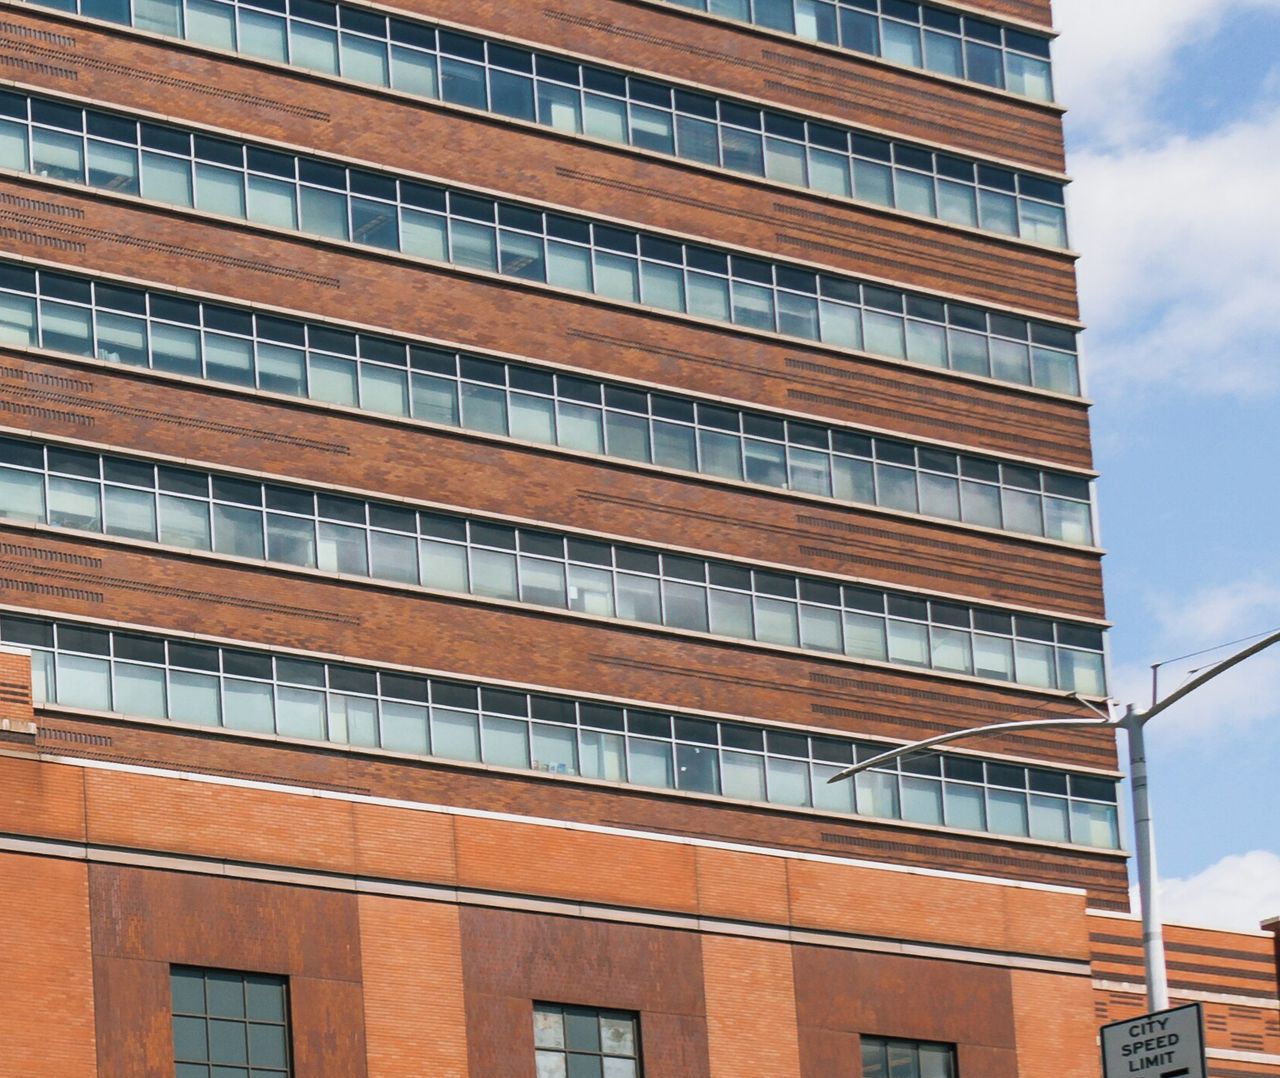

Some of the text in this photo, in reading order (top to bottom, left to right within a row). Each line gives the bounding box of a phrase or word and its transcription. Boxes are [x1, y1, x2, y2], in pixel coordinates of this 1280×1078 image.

[1129, 1018, 1169, 1038] CITY
[1121, 1033, 1179, 1057] SPEED
[1129, 1051, 1175, 1072] LIMIT
